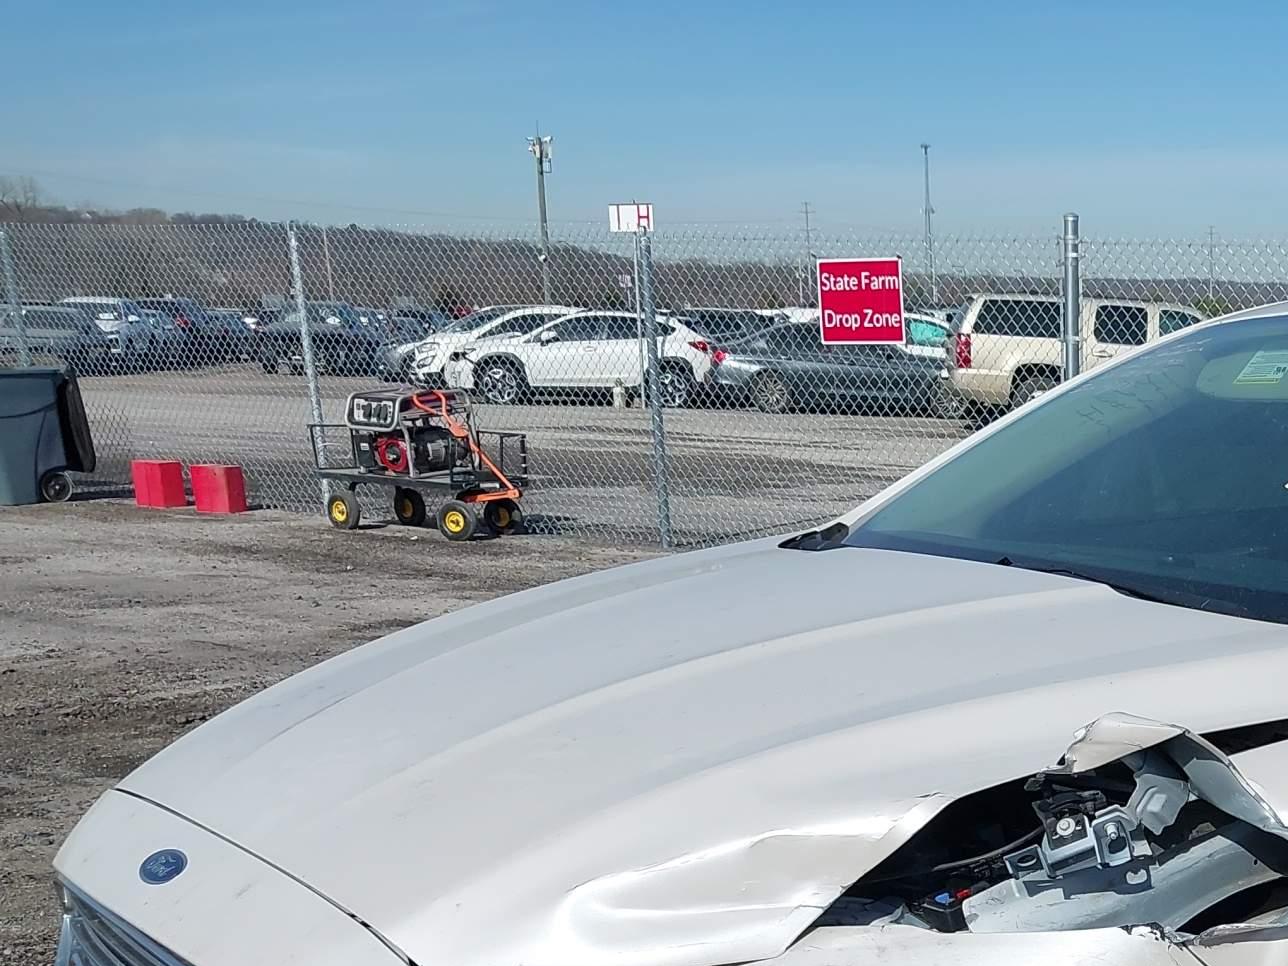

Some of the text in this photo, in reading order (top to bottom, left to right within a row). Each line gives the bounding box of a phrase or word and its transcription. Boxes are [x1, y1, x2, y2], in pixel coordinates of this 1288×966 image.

[821, 271, 899, 291] State Farm
[823, 308, 901, 331] Drop Zone
